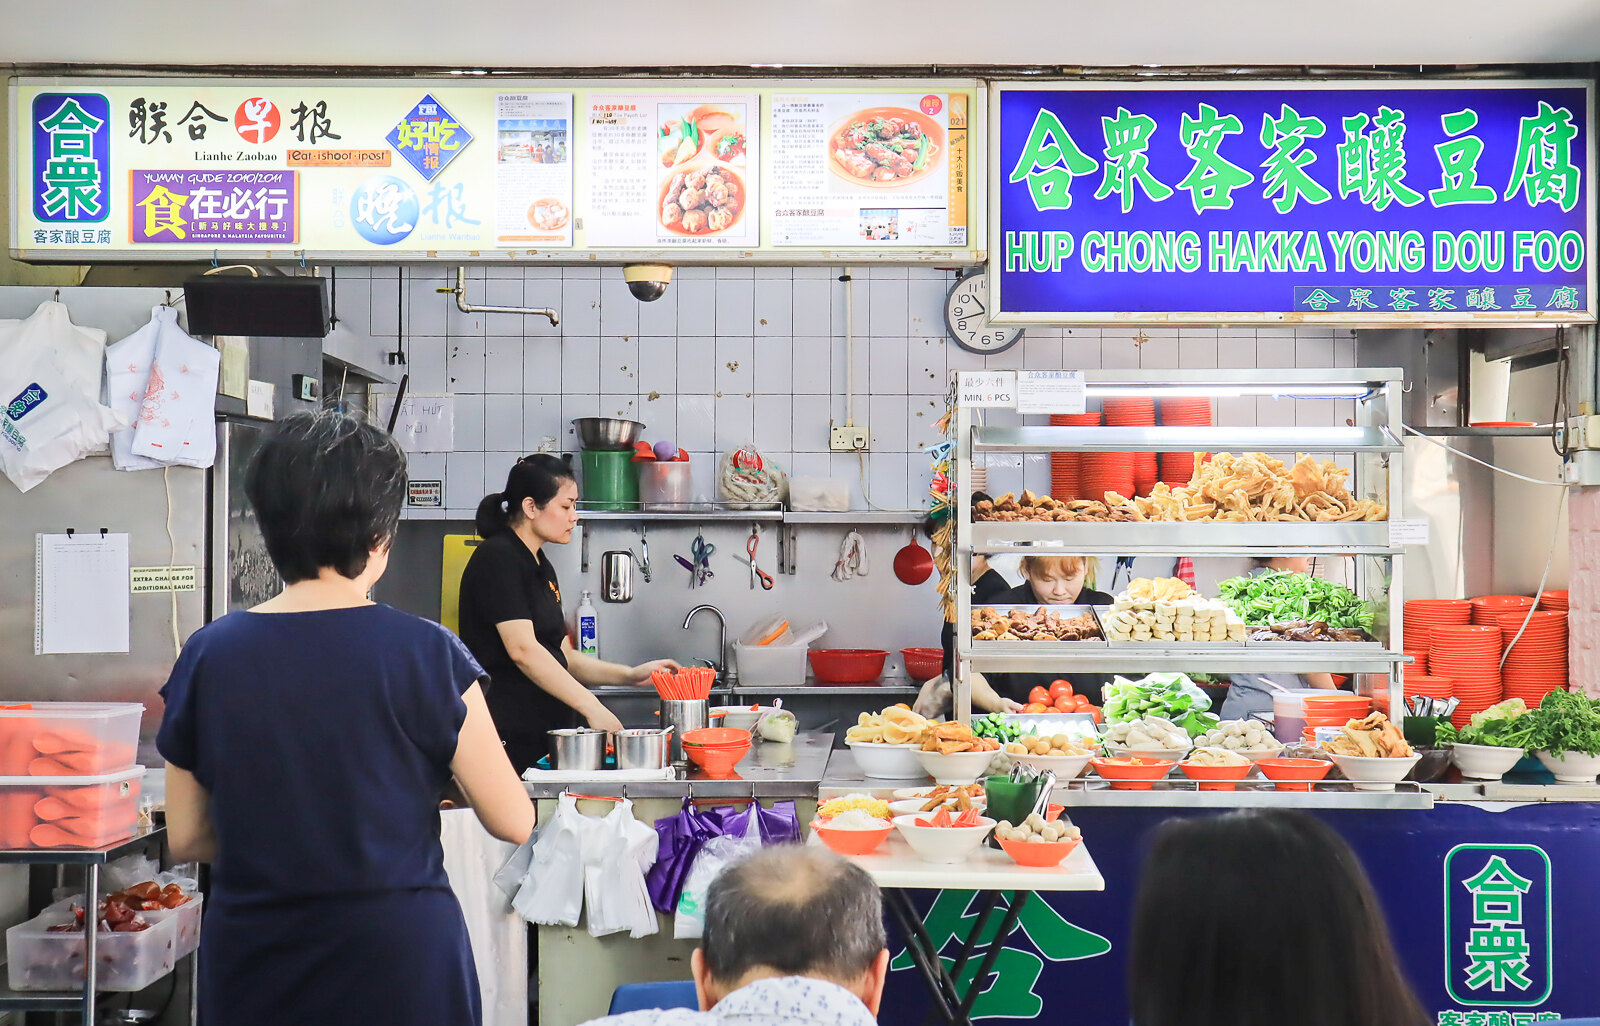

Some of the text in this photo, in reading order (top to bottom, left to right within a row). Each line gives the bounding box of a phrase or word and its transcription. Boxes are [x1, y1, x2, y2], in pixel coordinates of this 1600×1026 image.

[418, 104, 438, 116] FBI
[928, 107, 935, 115] 2
[950, 117, 964, 126] 021
[397, 118, 461, 151] 好吃
[194, 151, 278, 161] Lianhe Zaobao
[423, 141, 440, 170] 情报
[143, 173, 284, 185] YUMMY GUIDE 2010/2011
[33, 229, 112, 245] 客家酿豆腐
[420, 232, 481, 241] Lianhe Wanbao
[1005, 230, 1075, 273] HUP
[1081, 230, 1202, 273] CHONG
[1208, 230, 1327, 273] HAKKA
[1327, 230, 1426, 273] YONG
[1432, 230, 1505, 273] DOU
[1512, 230, 1585, 273] FOO
[968, 283, 978, 293] 11
[958, 294, 971, 304] 10
[953, 306, 963, 317] 9
[957, 320, 967, 331] 8
[967, 331, 977, 341] 7
[981, 335, 991, 345] 6
[995, 331, 1005, 341] 5
[964, 394, 1011, 402] MIN. 6 PCS
